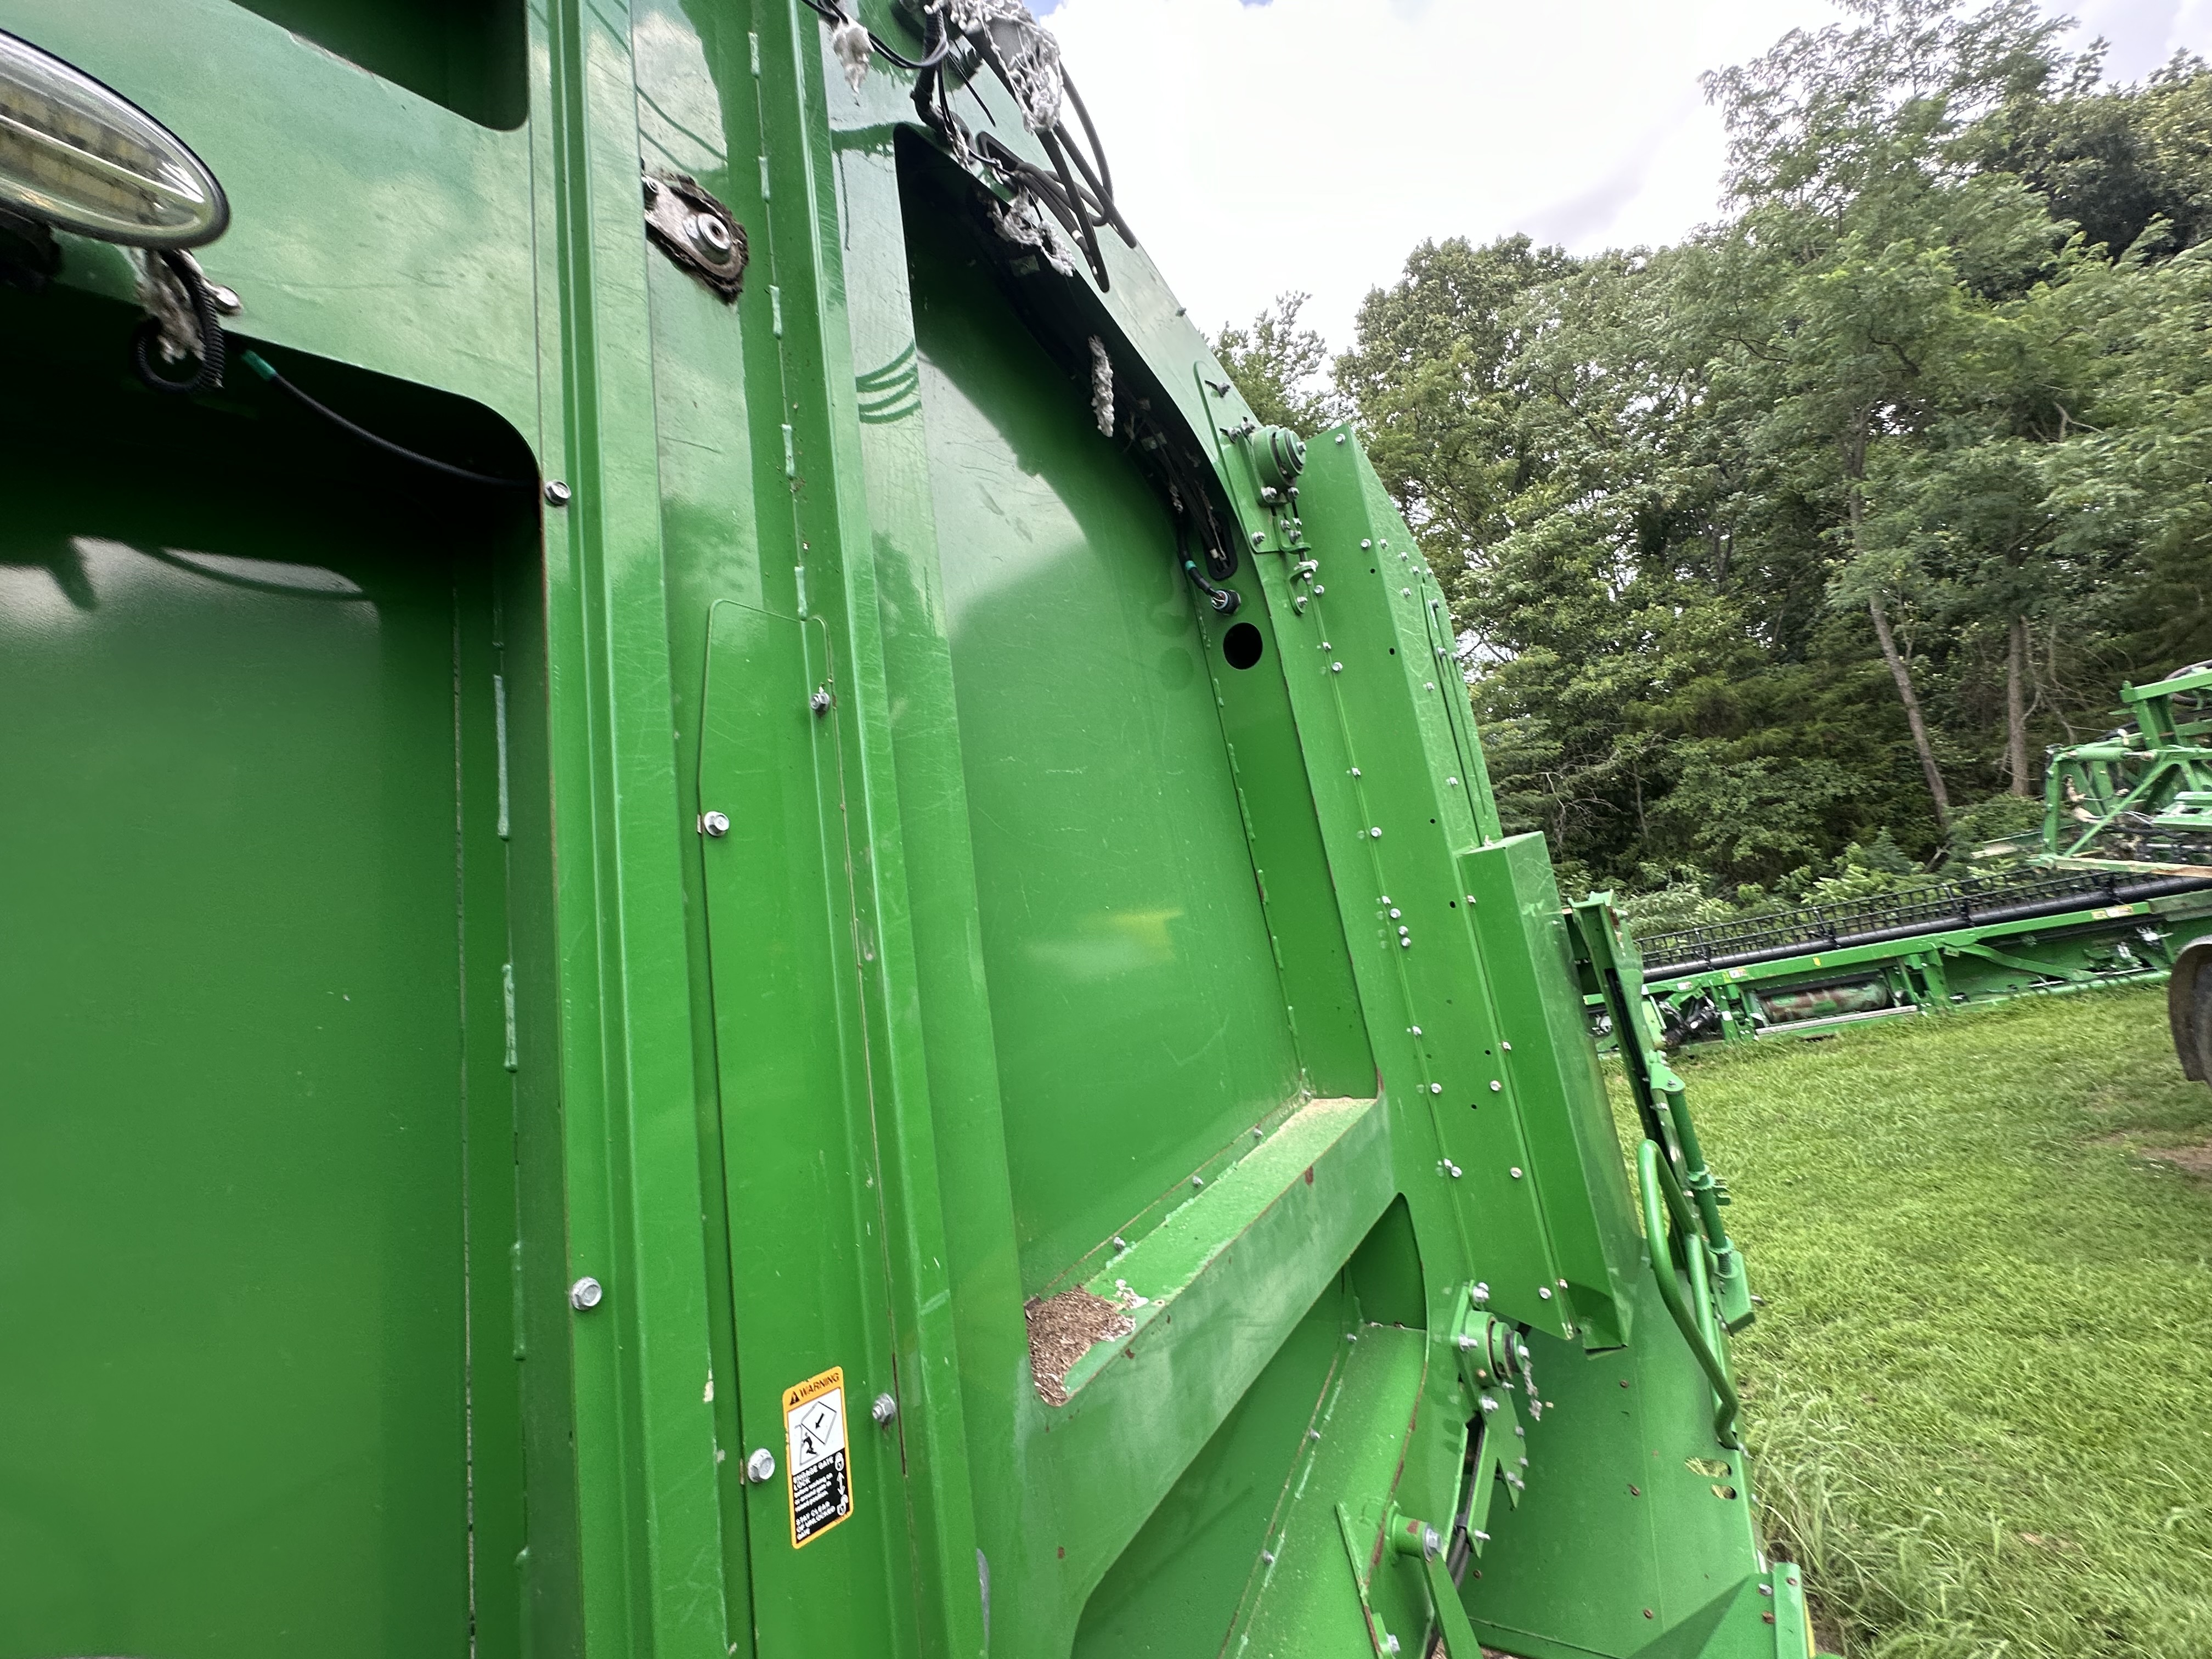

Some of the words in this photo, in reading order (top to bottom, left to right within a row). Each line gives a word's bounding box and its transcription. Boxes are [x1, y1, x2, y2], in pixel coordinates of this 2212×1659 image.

[799, 1373, 839, 1398] WARNING
[818, 1456, 834, 1470] GATE
[810, 1501, 830, 1517] CLEAR
